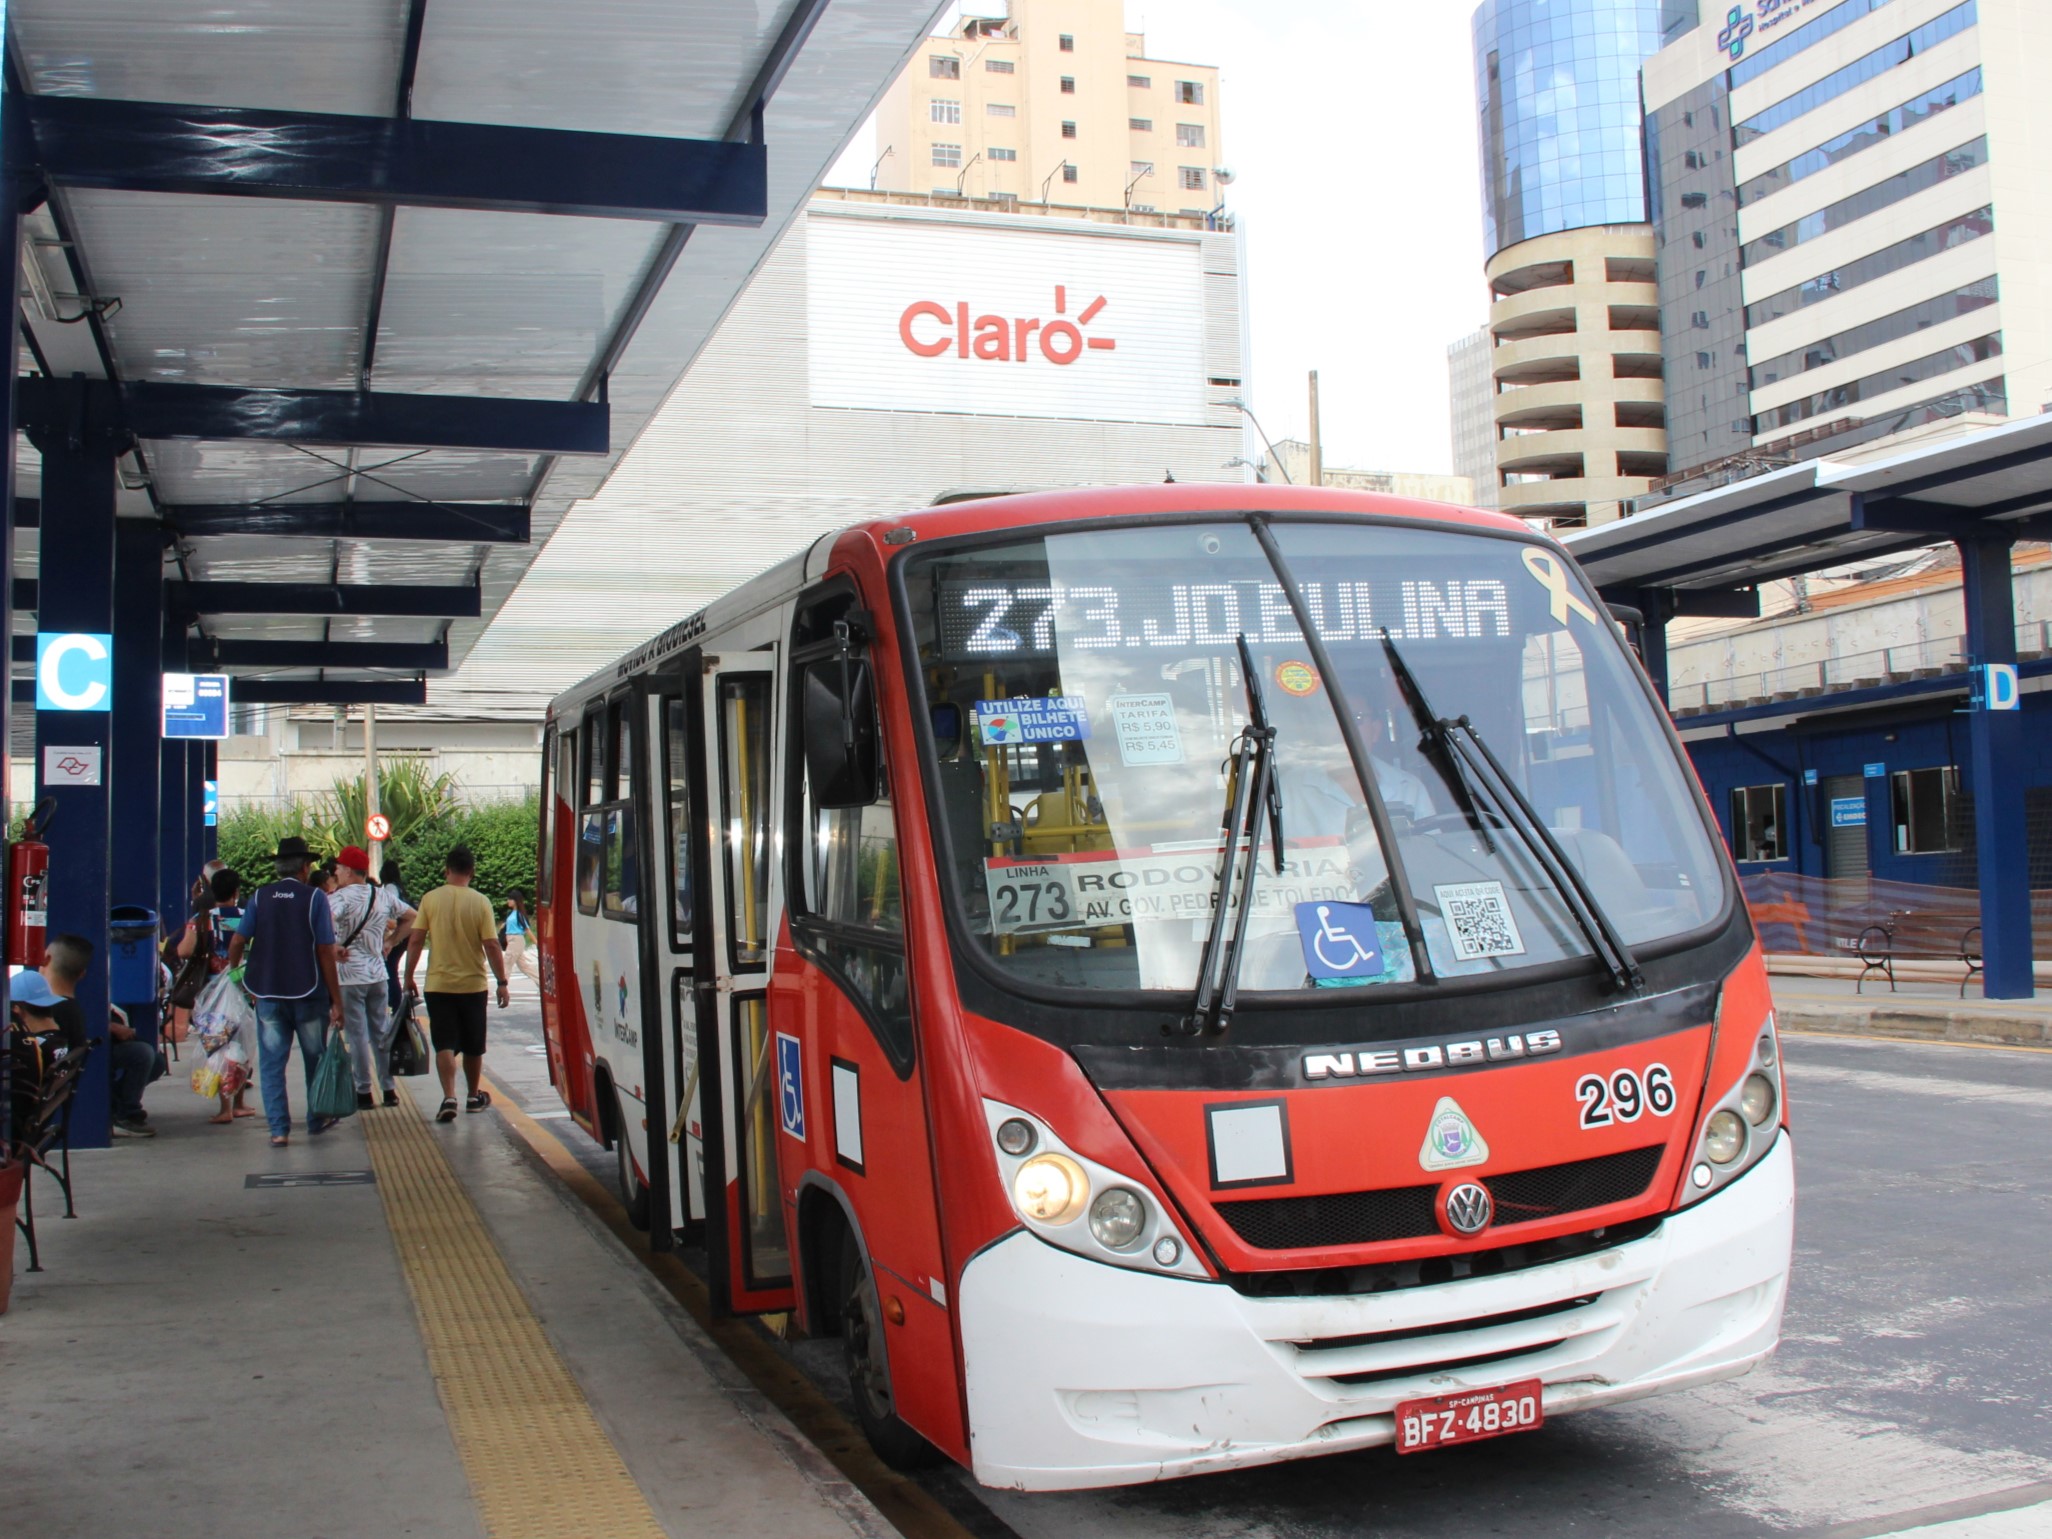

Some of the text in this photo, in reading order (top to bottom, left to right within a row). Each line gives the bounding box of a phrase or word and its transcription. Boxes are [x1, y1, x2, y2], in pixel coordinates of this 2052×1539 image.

[899, 300, 1083, 365] Claro
[40, 633, 108, 711] C
[1987, 663, 2019, 711] D
[982, 697, 1085, 715] UTILIZE AQUI
[1119, 710, 1169, 720] TARIFA
[1021, 711, 1088, 726] BILHETE
[1121, 721, 1172, 733] R$ 5,90
[1023, 725, 1076, 740] ÚNICO
[1125, 739, 1176, 751] R$ 5,45
[1006, 866, 1050, 879] LINHA
[272, 891, 295, 899] José
[996, 881, 1071, 924] 273
[1086, 884, 1350, 919] AV. GOV. PEDRO DE TOLEDO
[1304, 1029, 1562, 1078] NEOBUS
[1575, 1063, 1677, 1130] 296
